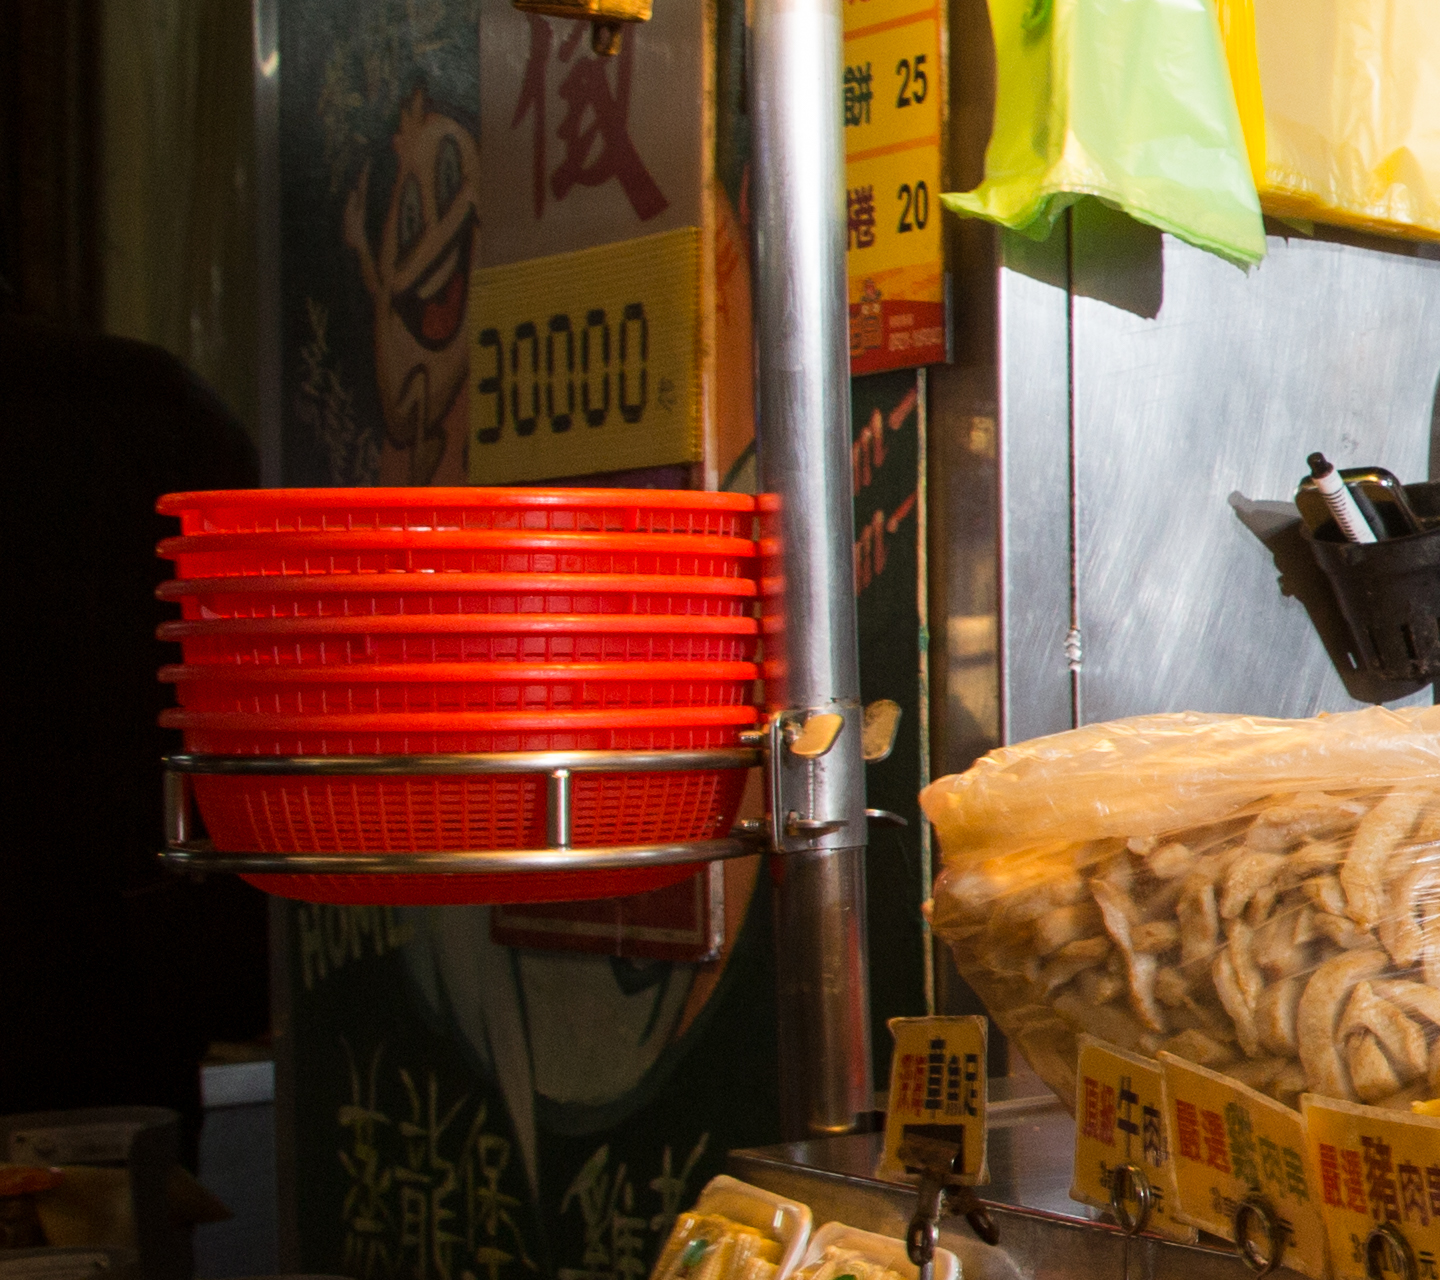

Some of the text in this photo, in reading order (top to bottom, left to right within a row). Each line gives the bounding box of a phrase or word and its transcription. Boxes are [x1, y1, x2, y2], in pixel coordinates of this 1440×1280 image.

[895, 53, 929, 110] 25
[896, 179, 930, 234] 20
[477, 302, 650, 446] 30000
